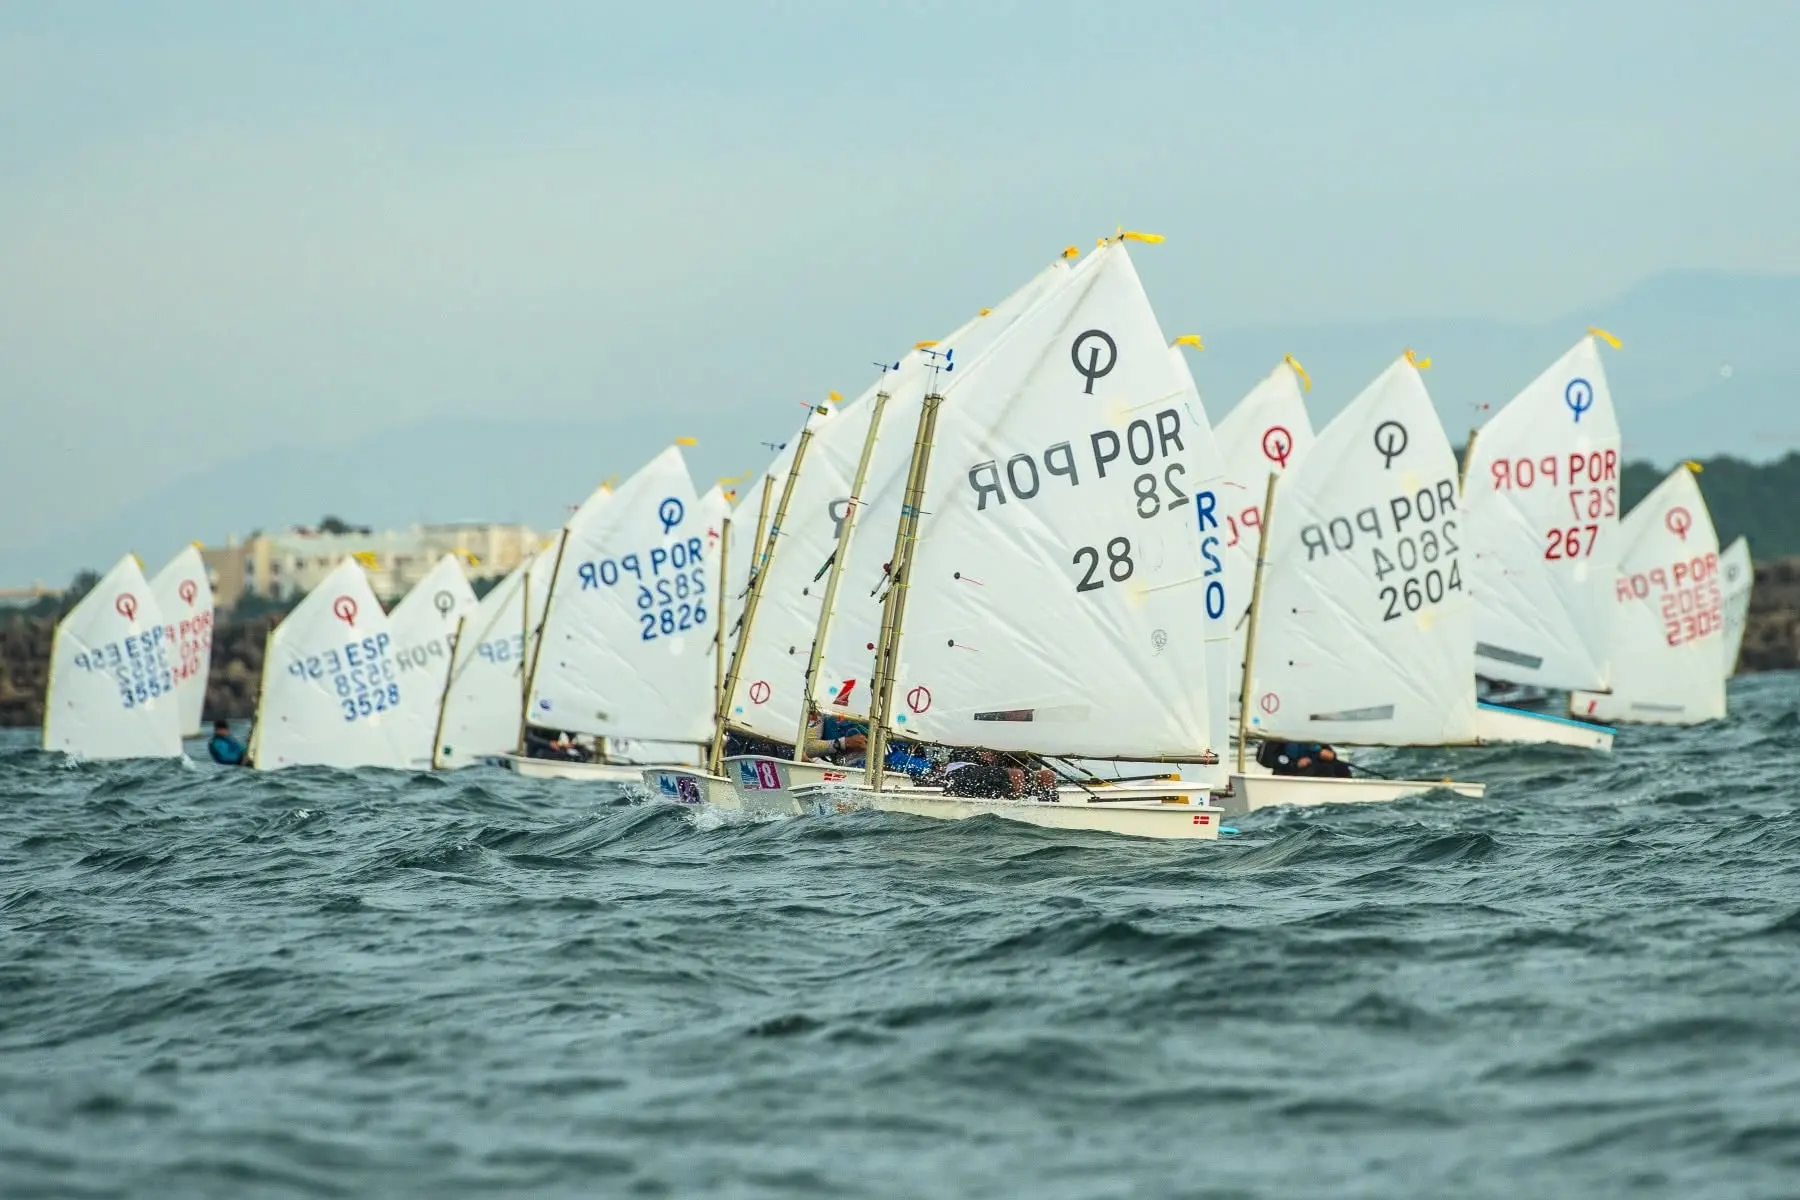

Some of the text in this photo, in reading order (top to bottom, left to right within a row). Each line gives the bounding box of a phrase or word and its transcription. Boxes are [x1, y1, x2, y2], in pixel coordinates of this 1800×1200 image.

[1090, 408, 1184, 478] POR
[1569, 449, 1616, 486] POR
[1390, 479, 1457, 533] POR
[651, 537, 703, 576] POR
[1544, 524, 1598, 560] 267
[1072, 537, 1134, 593] 28
[1673, 552, 1718, 587] POR
[1379, 558, 1463, 622] 2604
[640, 598, 707, 641] 2826
[125, 625, 163, 659] ESP
[344, 632, 390, 668] ESP
[121, 670, 172, 708] 3552
[342, 683, 400, 722] 3528
[762, 763, 775, 788] 8
